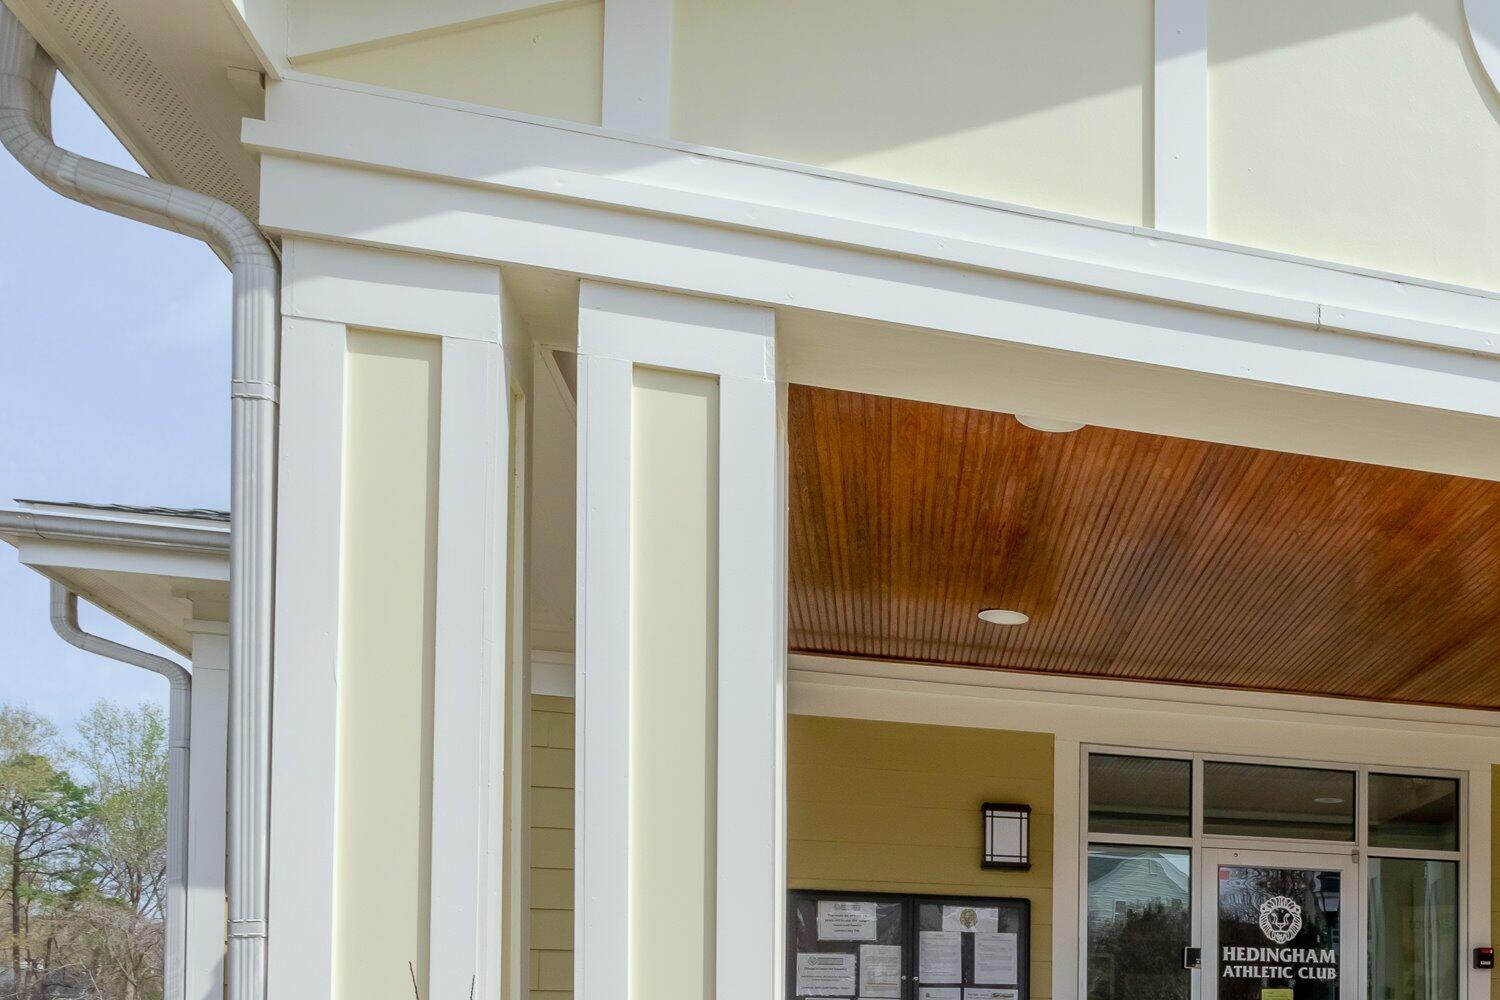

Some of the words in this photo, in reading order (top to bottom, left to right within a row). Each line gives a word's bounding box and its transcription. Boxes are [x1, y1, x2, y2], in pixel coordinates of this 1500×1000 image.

[1222, 946, 1336, 964] HEDINGHAM
[1222, 965, 1293, 979] ATHLETIC
[1298, 966, 1337, 980] CLUB
